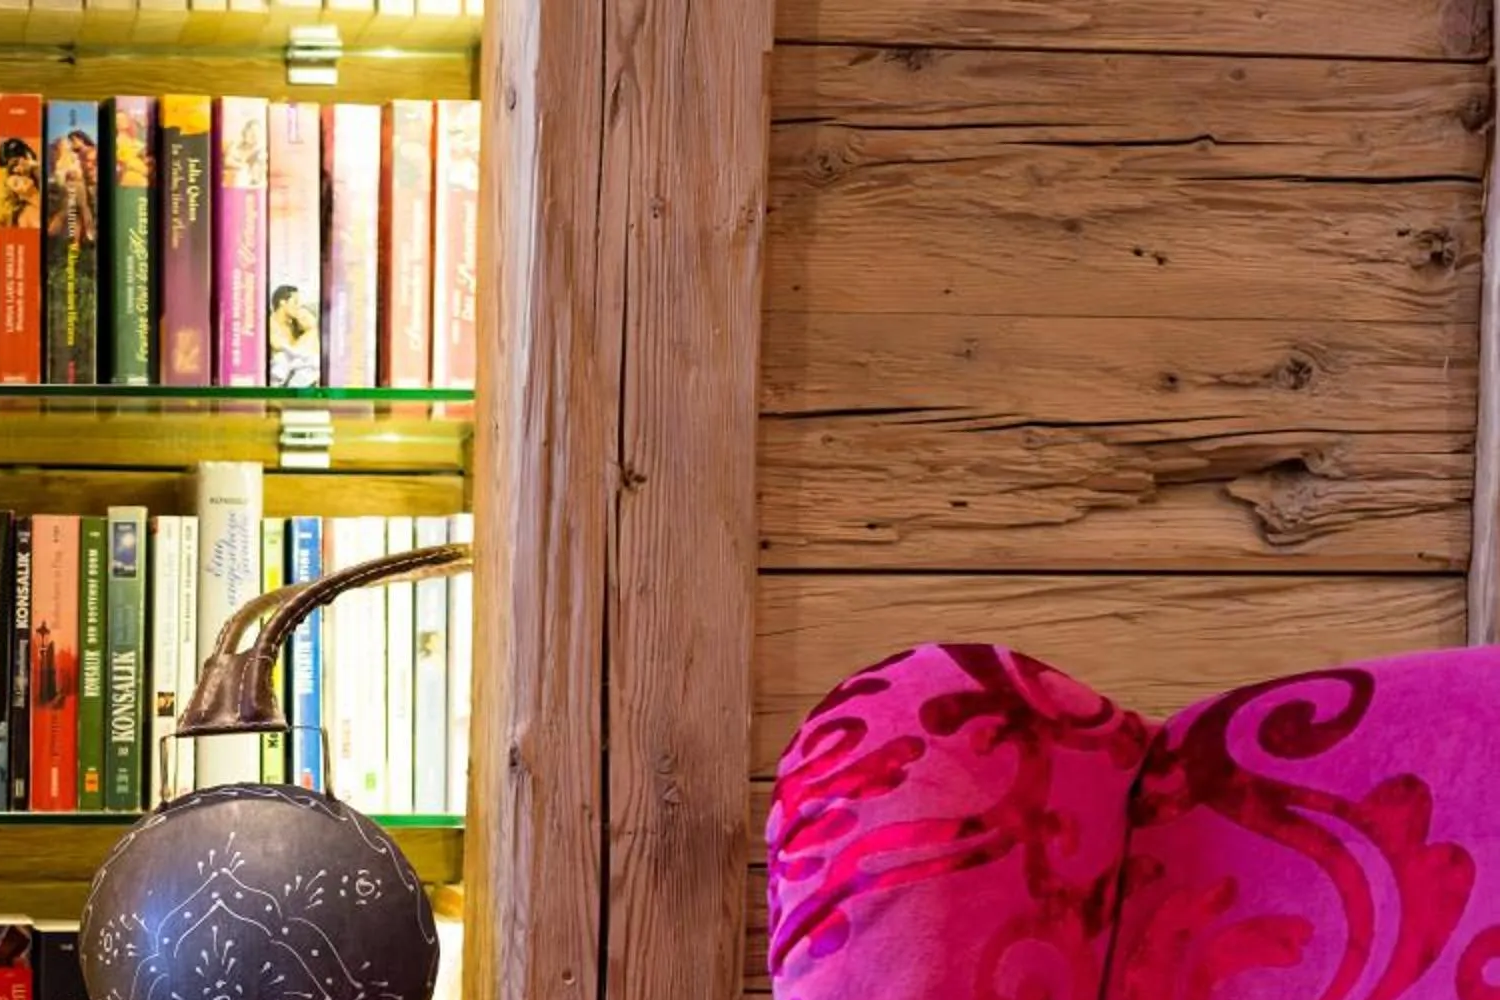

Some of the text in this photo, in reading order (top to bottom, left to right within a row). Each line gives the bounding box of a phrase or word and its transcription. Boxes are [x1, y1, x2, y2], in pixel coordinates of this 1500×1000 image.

[186, 157, 203, 222] Julia Quinn
[15, 551, 30, 629] KONSALIK
[83, 649, 101, 697] KONSALIK
[110, 650, 137, 743] KONSALIK
